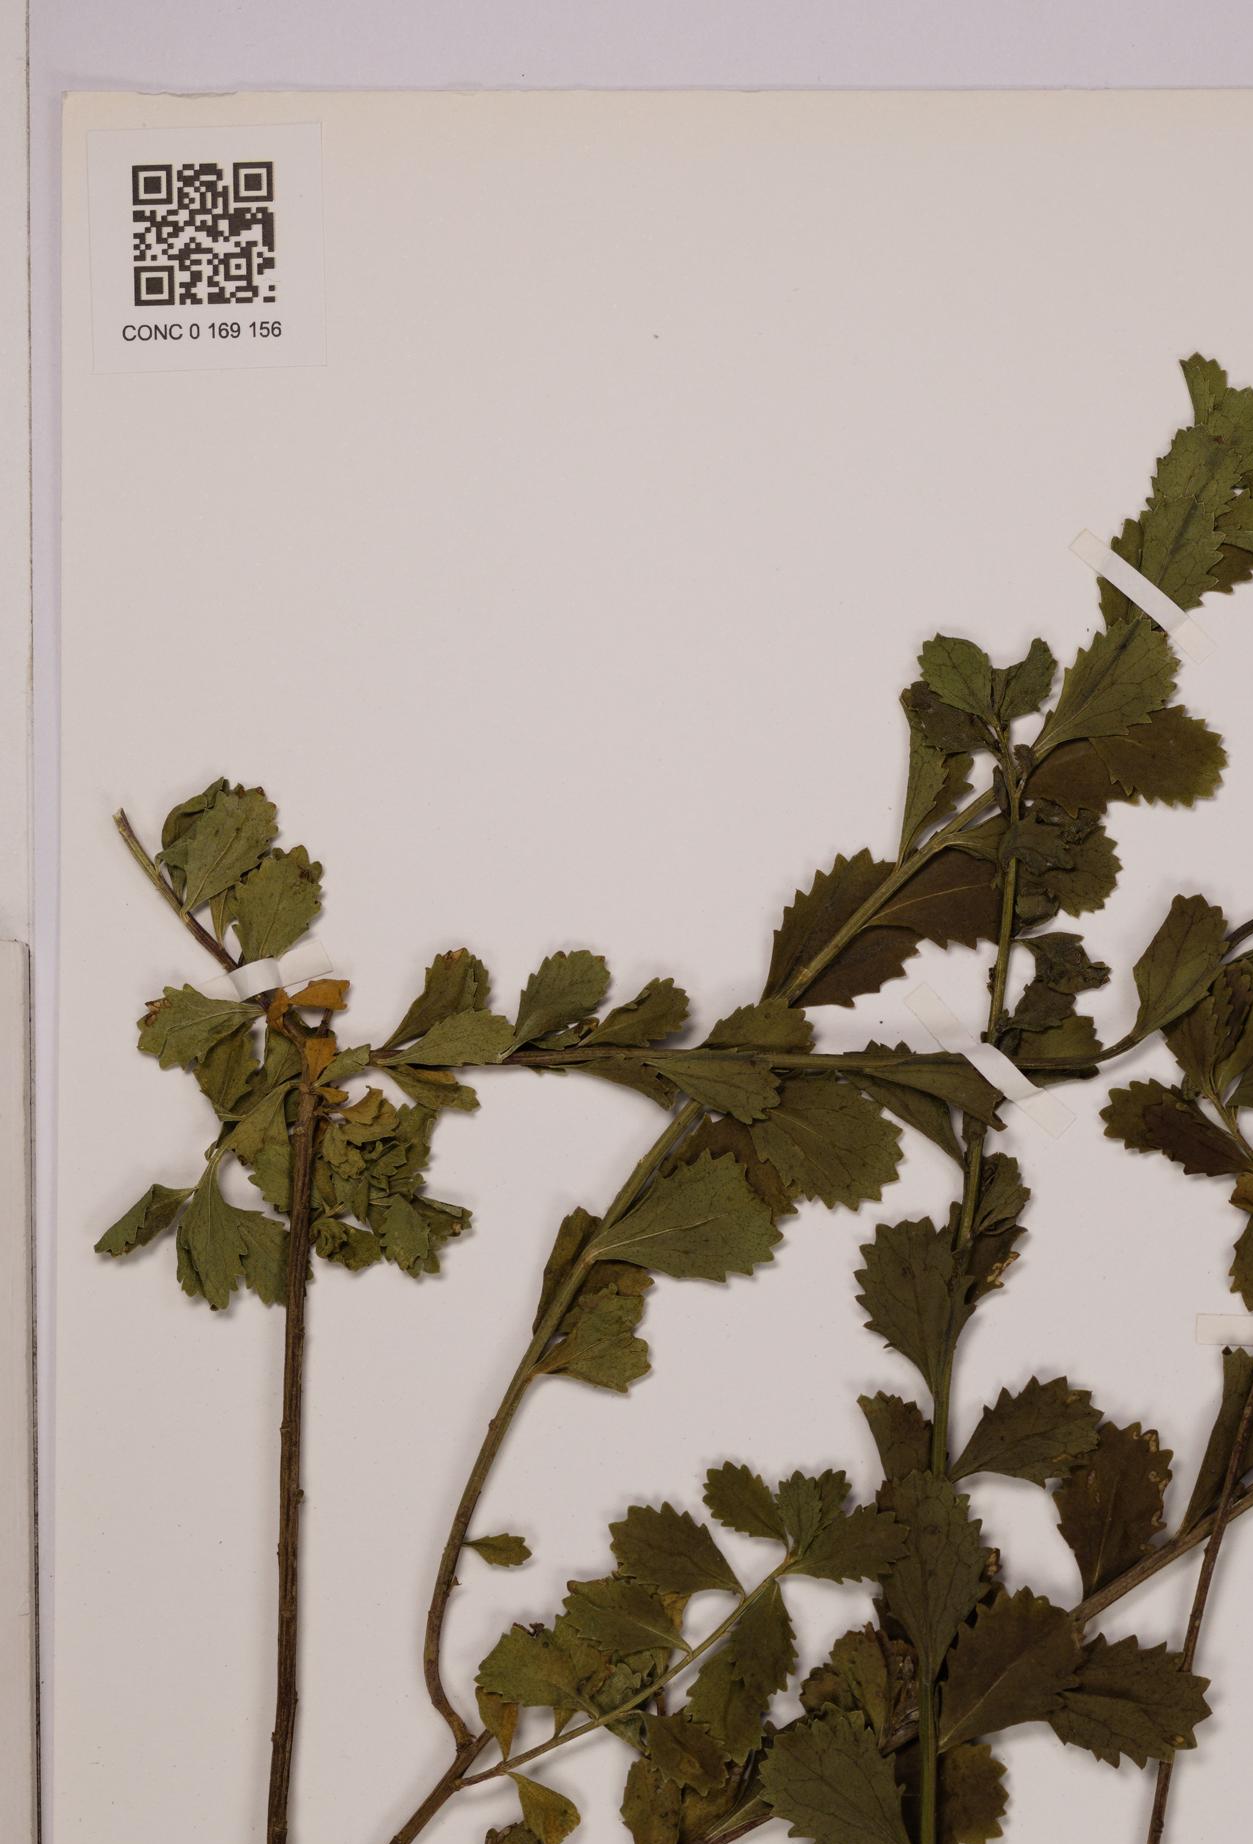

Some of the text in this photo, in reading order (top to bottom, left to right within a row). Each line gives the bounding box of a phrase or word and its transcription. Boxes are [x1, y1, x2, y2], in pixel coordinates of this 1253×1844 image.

[122, 321, 282, 341] CONC 0 169 156
